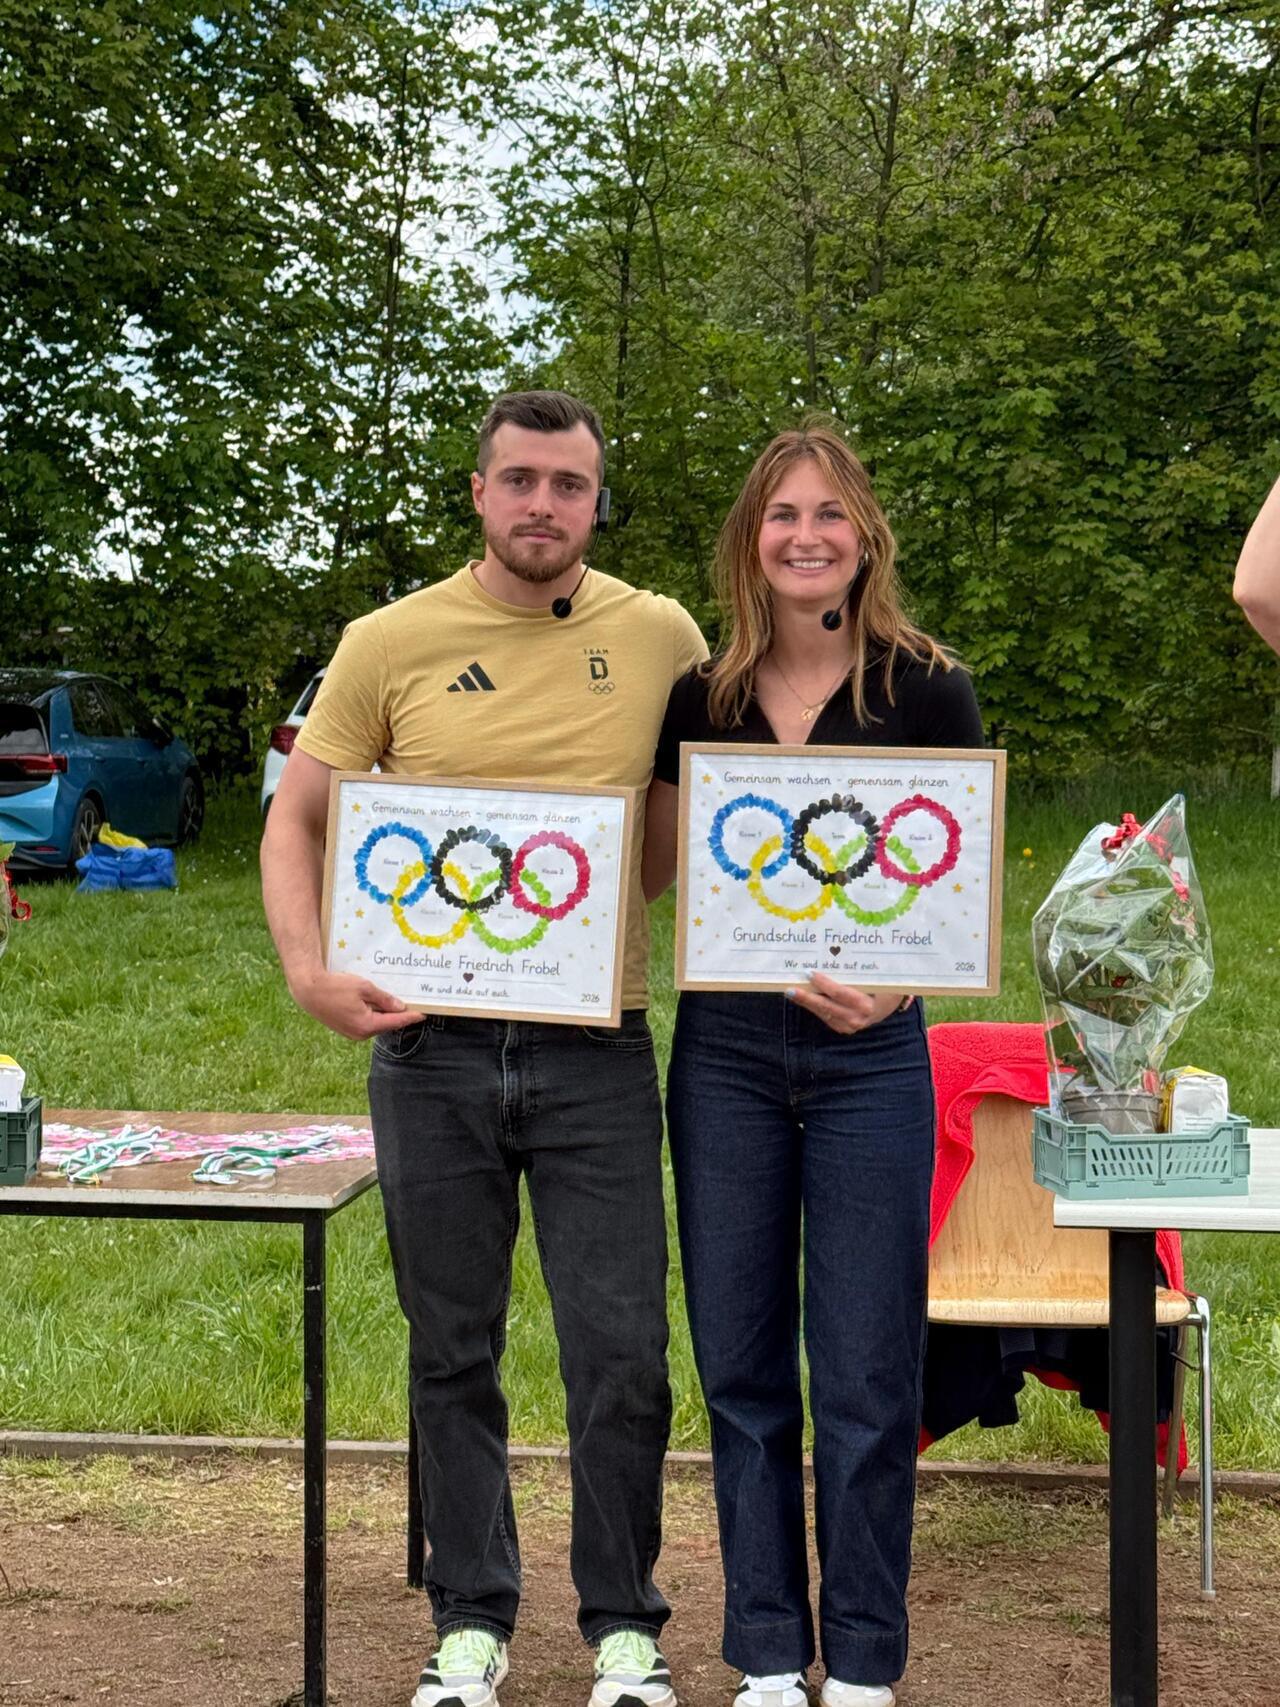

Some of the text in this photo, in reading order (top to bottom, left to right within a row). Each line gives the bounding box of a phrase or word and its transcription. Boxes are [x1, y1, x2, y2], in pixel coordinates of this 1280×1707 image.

[724, 771, 781, 784] Gemeinsam
[786, 773, 832, 785] wachsen
[847, 777, 903, 788] gemeinsam
[371, 801, 425, 816] Gemeinsam
[430, 804, 472, 818] wachsen
[486, 811, 538, 822] gemeinsam
[732, 926, 817, 944] Grundschule
[824, 928, 884, 944] Friedrich
[373, 950, 452, 970] Grundschule
[458, 954, 514, 974] Friedrich
[843, 961, 858, 970] auf
[954, 961, 976, 972] 2026
